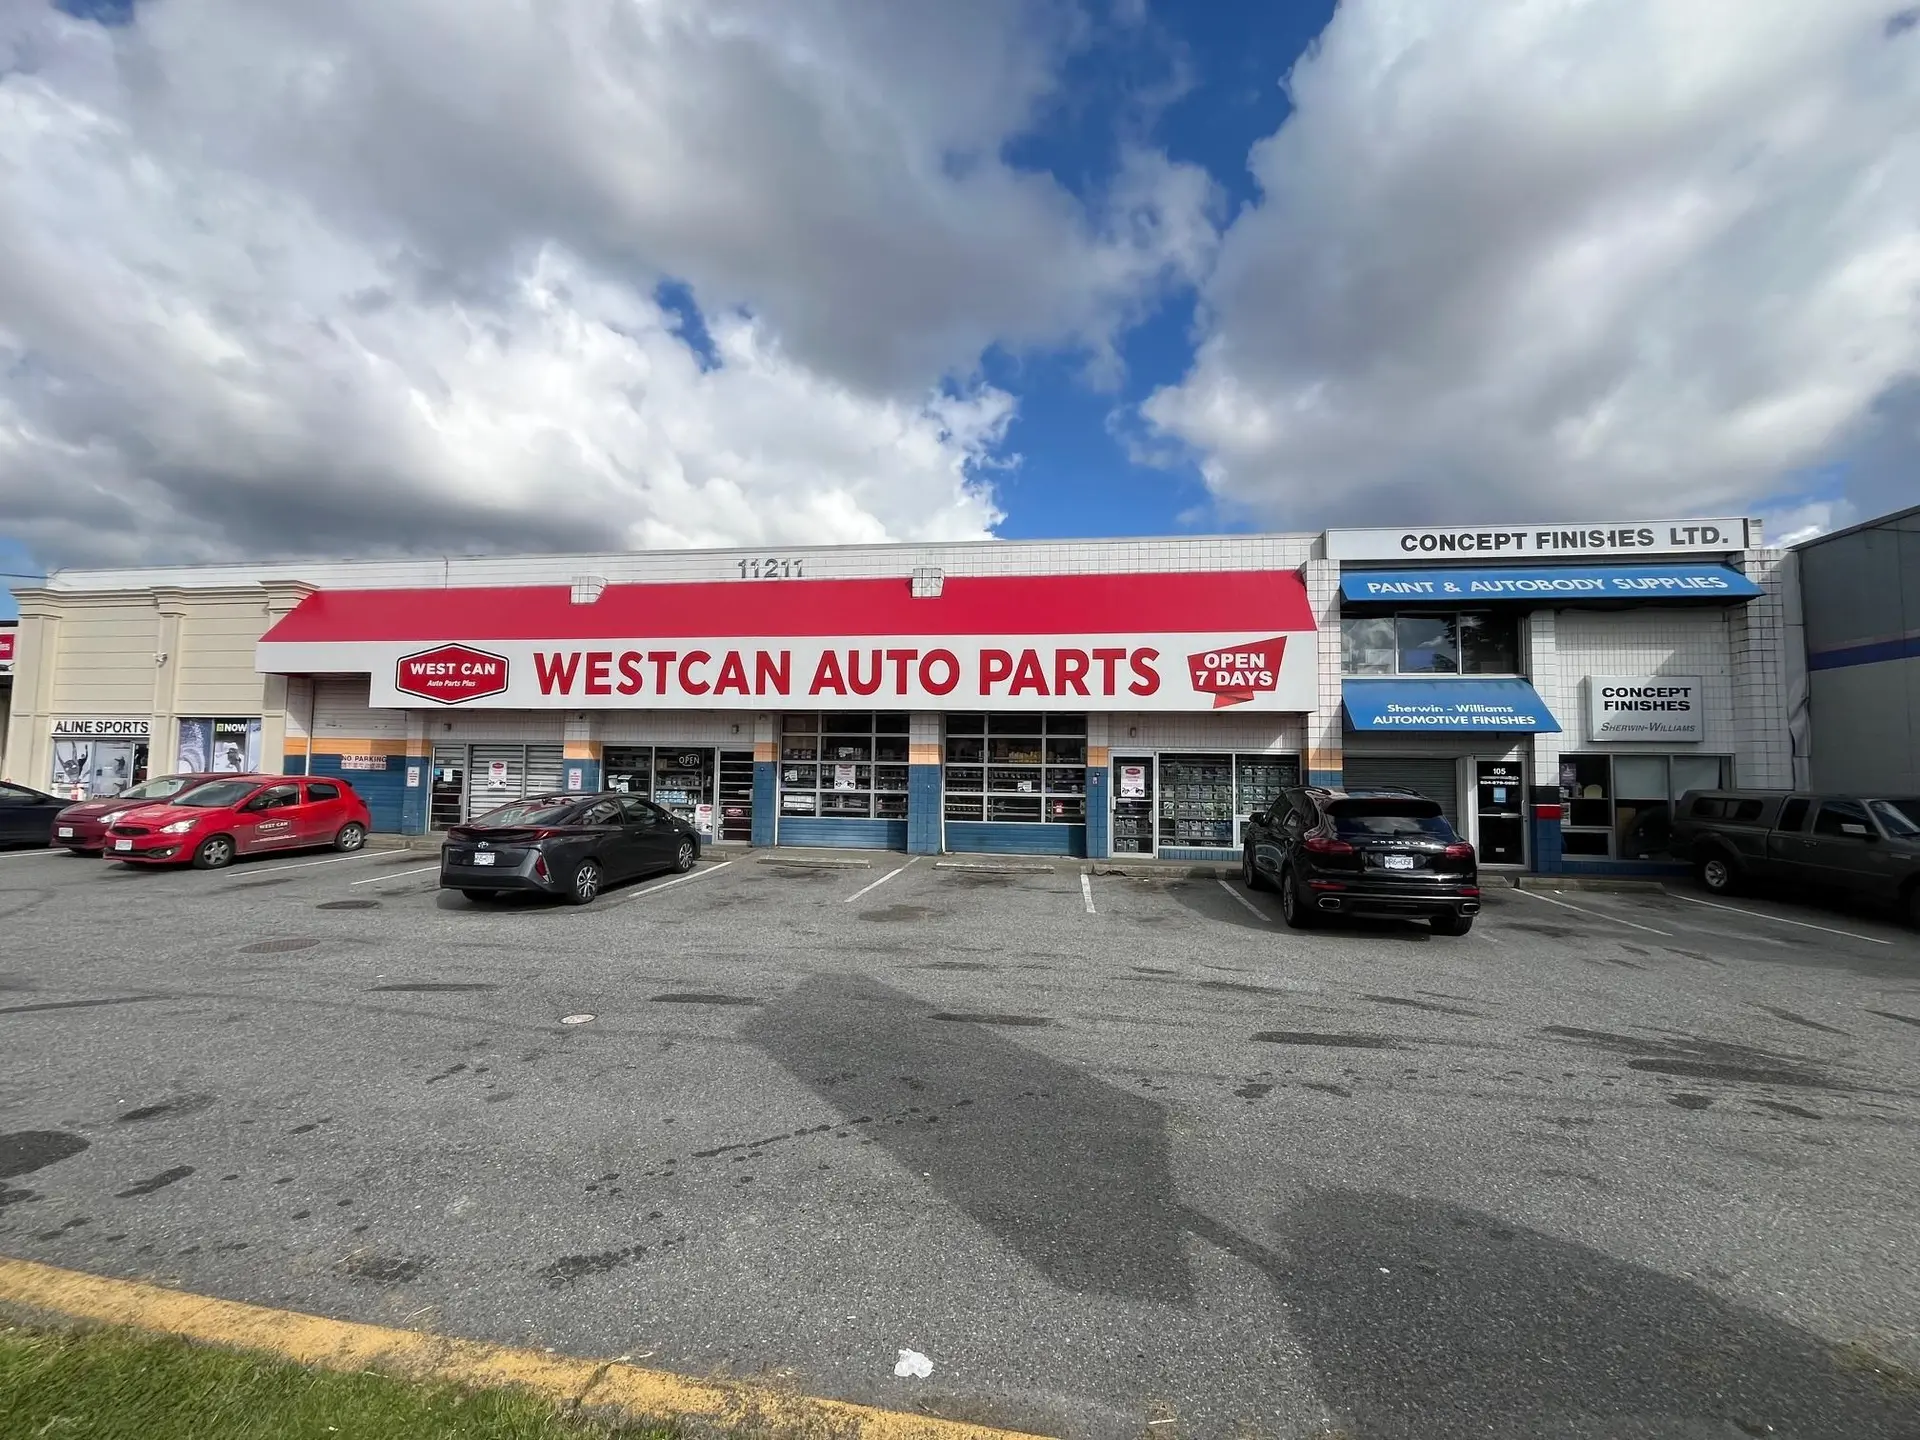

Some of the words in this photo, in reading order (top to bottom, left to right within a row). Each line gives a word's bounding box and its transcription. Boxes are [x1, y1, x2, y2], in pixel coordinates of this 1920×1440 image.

[1400, 533, 1528, 552] CONCEPT
[1536, 528, 1655, 549] FINISHES
[1670, 526, 1729, 546] LTD.
[738, 558, 803, 579] 11211
[1367, 580, 1434, 594] PAINT
[1443, 582, 1463, 593] &
[1470, 578, 1604, 592] AUTOBODY
[1612, 576, 1729, 590] SUPPLIES
[1203, 653, 1265, 669] OPEN
[409, 662, 456, 675] WEST
[460, 662, 496, 675] CAN
[532, 650, 791, 696] WESTCAN
[808, 648, 961, 697] AUTO
[979, 646, 1161, 696] PARTS
[1195, 671, 1209, 686] 7
[1216, 670, 1274, 686] DAYS
[1601, 687, 1691, 698] CONCEPT
[1387, 704, 1443, 713] Sherwin
[1455, 704, 1514, 713] Williams
[1604, 700, 1691, 711] FINISHES
[1373, 715, 1469, 725] AUTOMOTIVE
[1472, 715, 1536, 725] FINISHES
[54, 721, 93, 733] ALINE
[95, 721, 149, 734] SPORTS
[354, 755, 387, 763] PARKING
[679, 755, 700, 765] OPEN
[1493, 767, 1506, 775] 105
